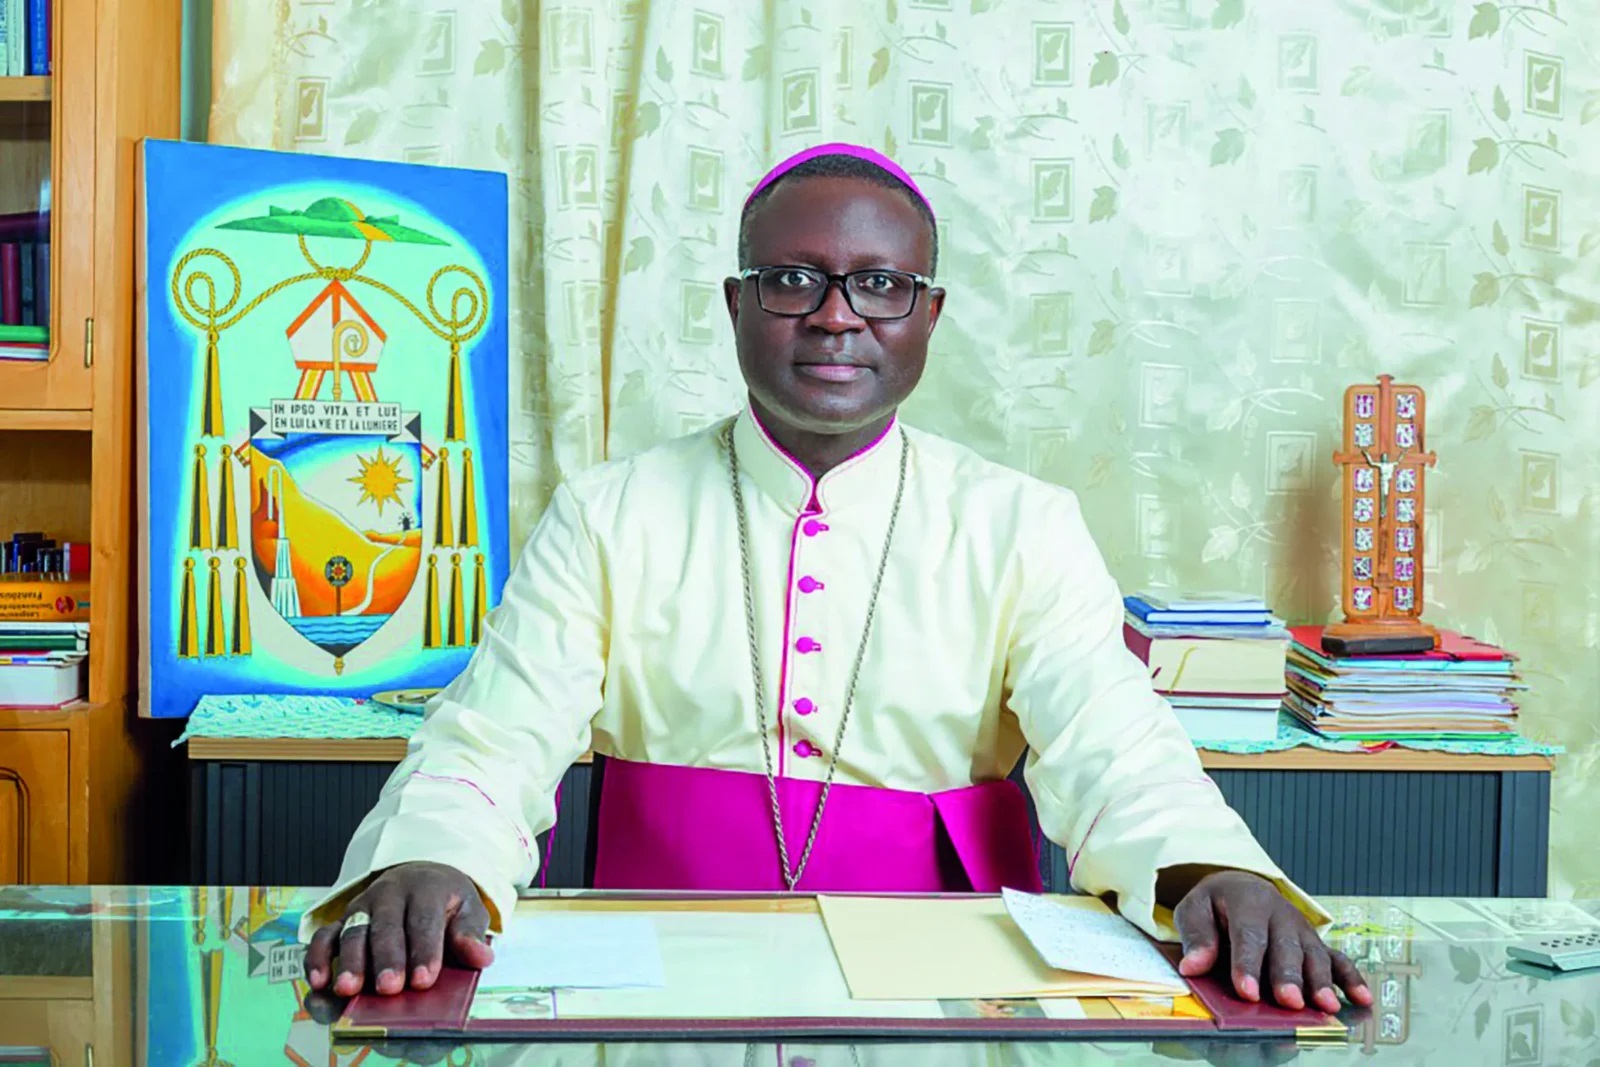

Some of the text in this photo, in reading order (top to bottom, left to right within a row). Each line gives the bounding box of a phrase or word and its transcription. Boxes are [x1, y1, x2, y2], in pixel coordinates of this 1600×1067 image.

[274, 404, 397, 417] IN IPSO VITA ET LUX
[275, 417, 287, 428] EN
[290, 418, 304, 429] LUI
[306, 418, 316, 429] LA
[335, 419, 346, 430] ET
[350, 420, 360, 430] LA
